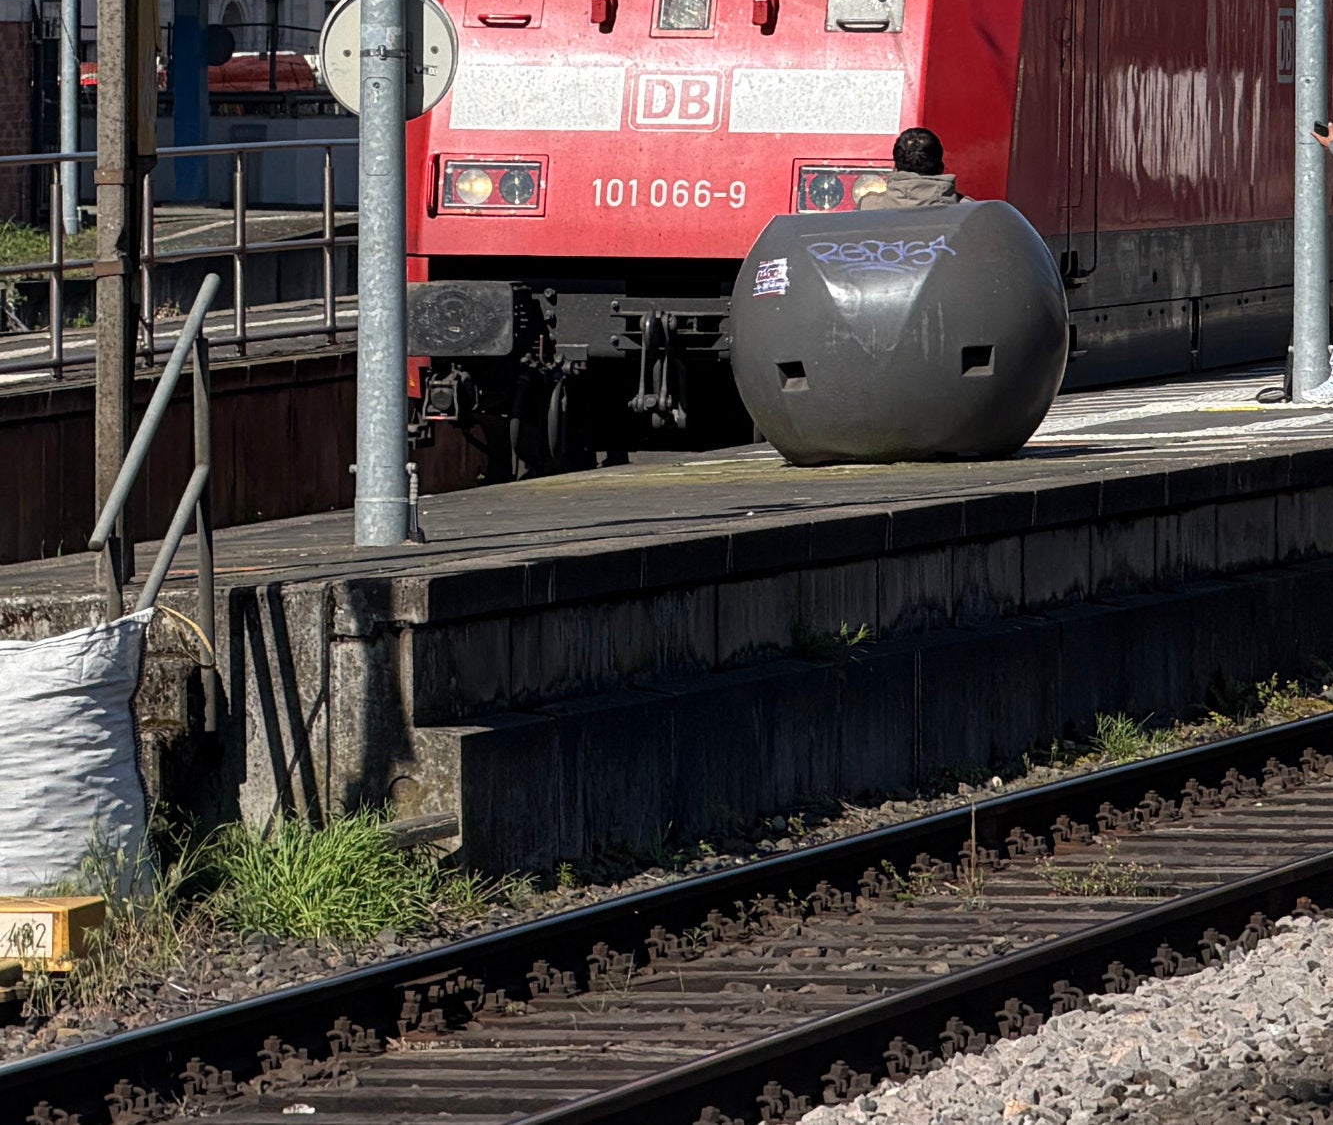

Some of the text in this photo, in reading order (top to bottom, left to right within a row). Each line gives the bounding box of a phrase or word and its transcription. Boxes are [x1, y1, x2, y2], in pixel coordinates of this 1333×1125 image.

[1279, 20, 1292, 70] DB
[643, 78, 710, 120] DB
[592, 178, 746, 209] 101 066-9
